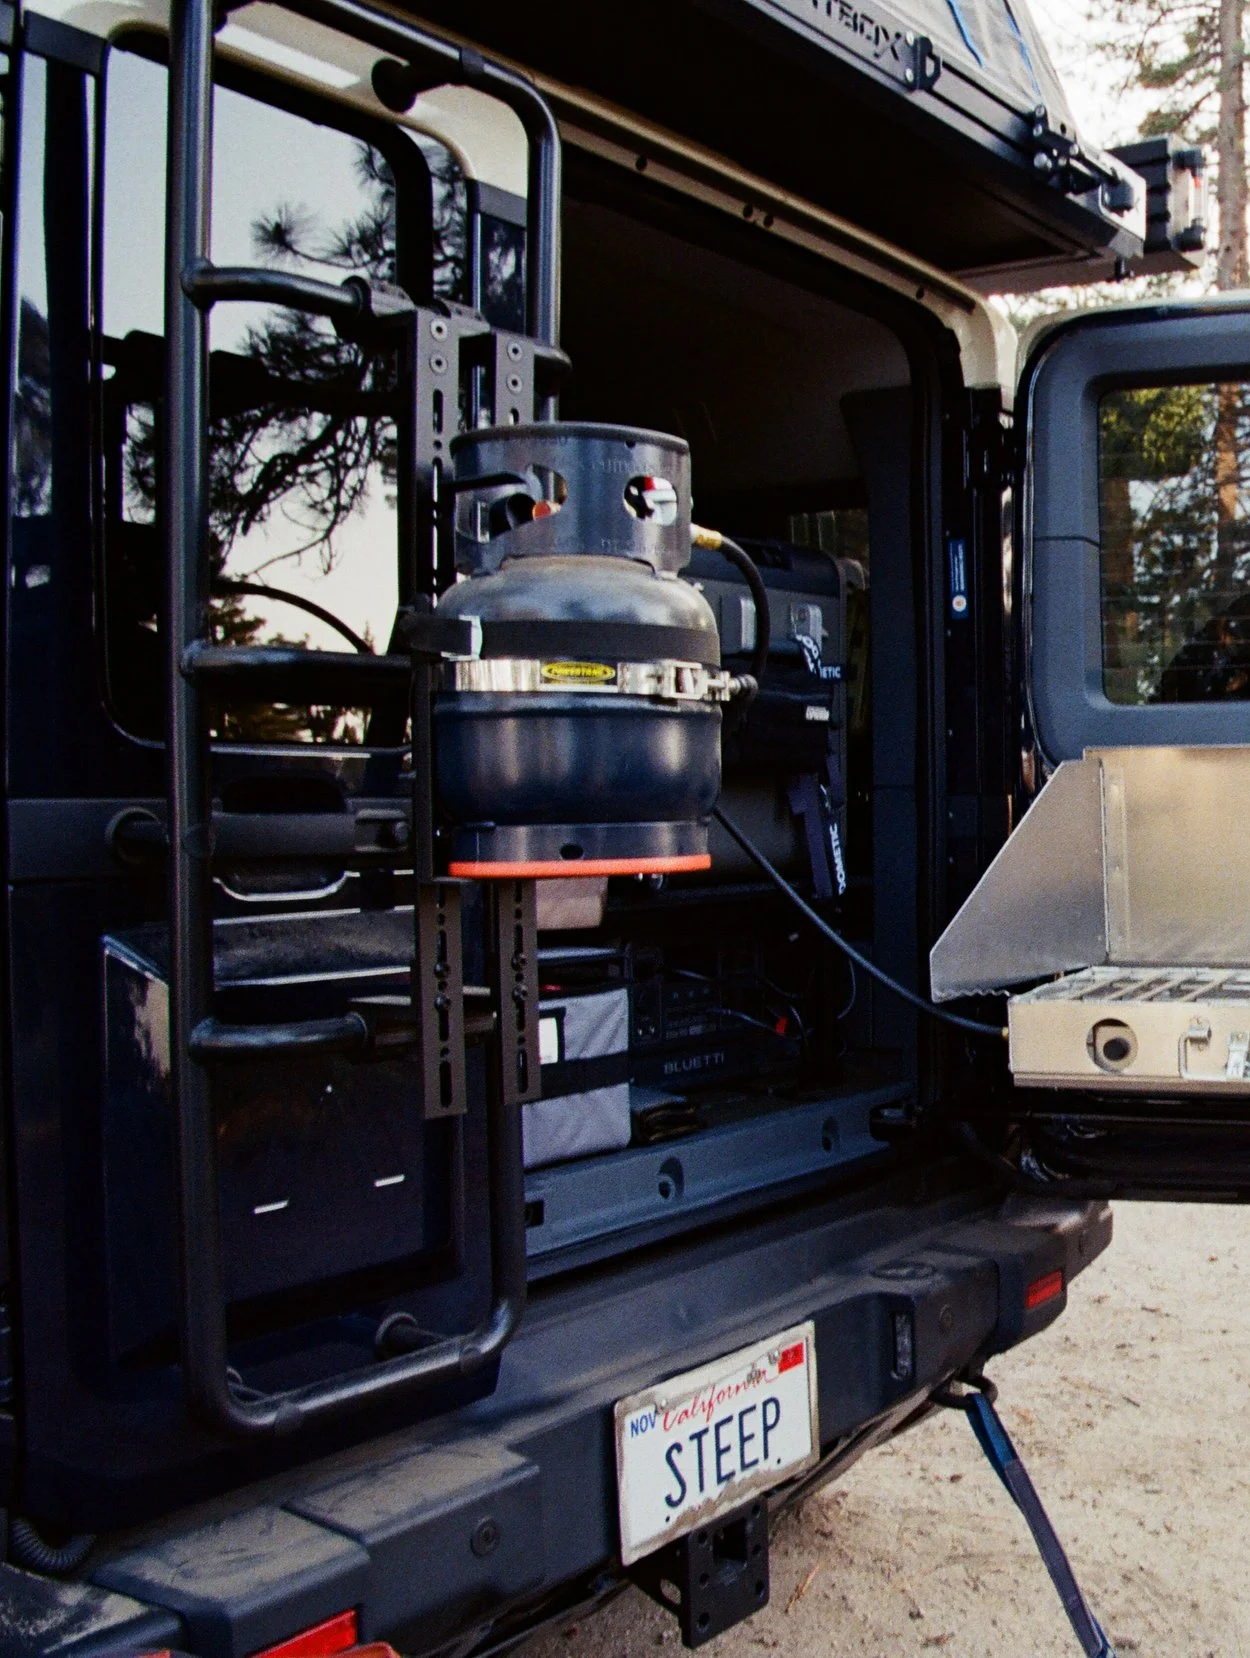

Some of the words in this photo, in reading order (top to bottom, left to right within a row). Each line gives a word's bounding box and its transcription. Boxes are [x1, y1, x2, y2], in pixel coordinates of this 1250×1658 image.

[663, 1052, 725, 1075] BLUETTI
[630, 1405, 657, 1438] NOV
[664, 1396, 781, 1508] STEEP
